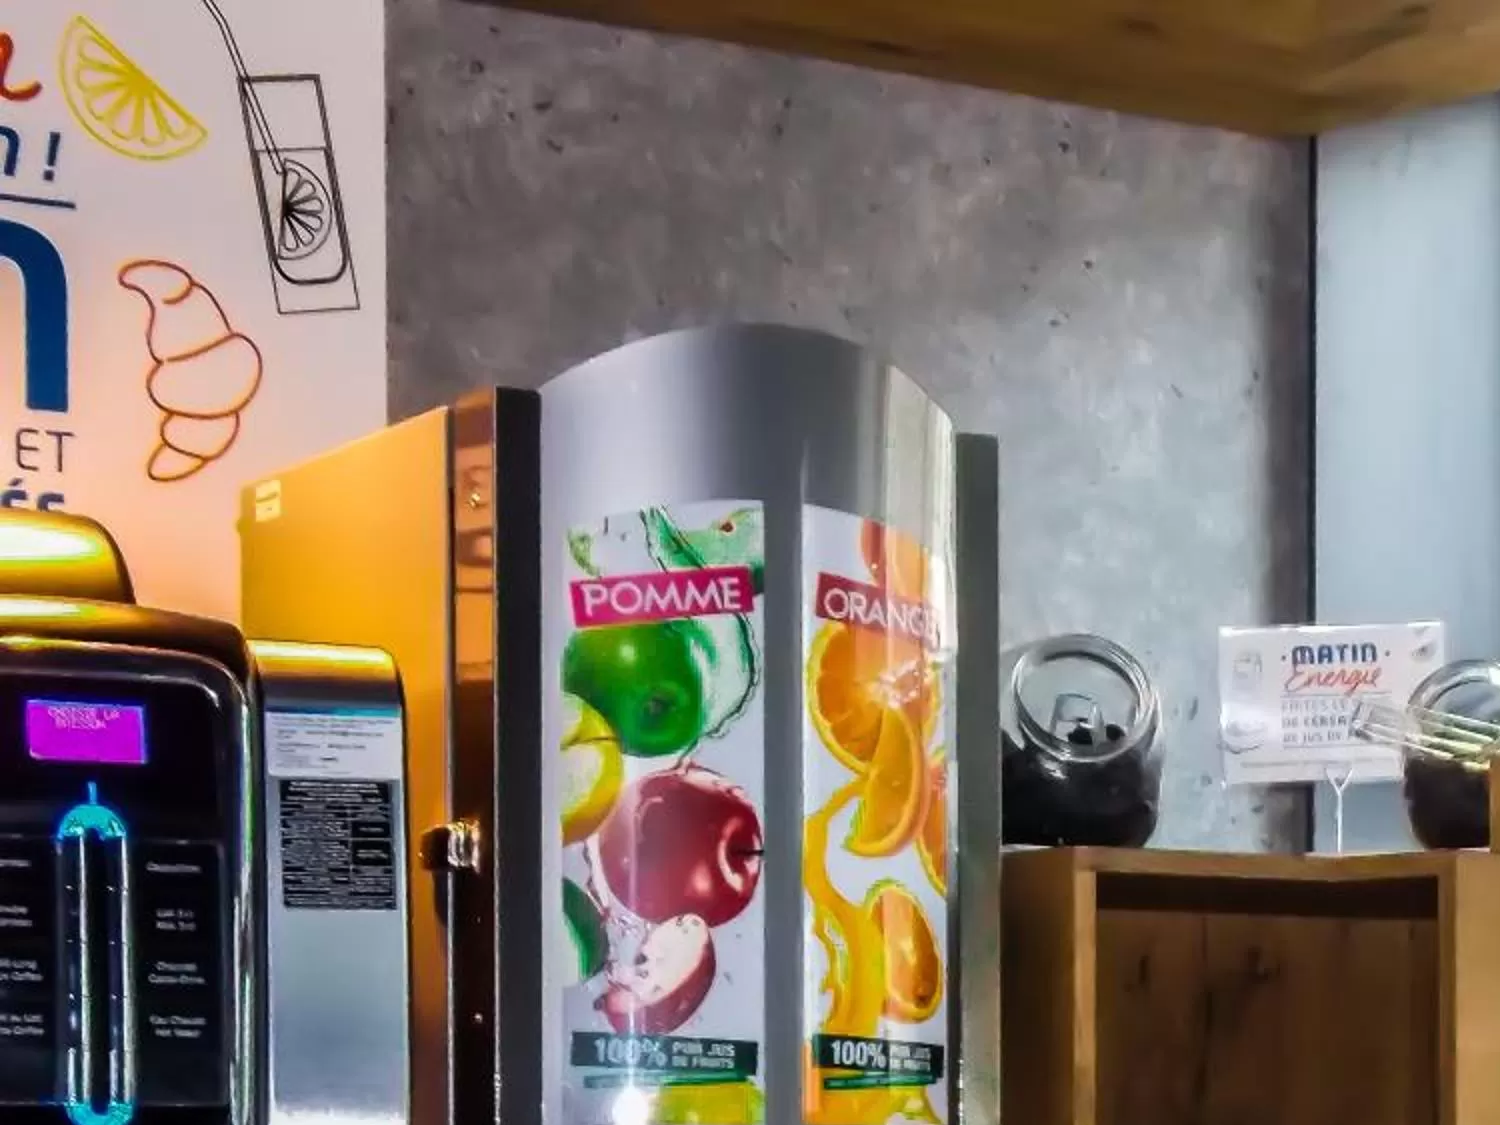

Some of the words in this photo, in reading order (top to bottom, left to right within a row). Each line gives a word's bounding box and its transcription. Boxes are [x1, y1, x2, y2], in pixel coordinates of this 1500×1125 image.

[15, 428, 76, 473] ET
[579, 576, 742, 617] POMME
[1292, 642, 1378, 664] MATIN
[594, 1037, 668, 1068] 100%
[831, 1040, 888, 1069] 100%
